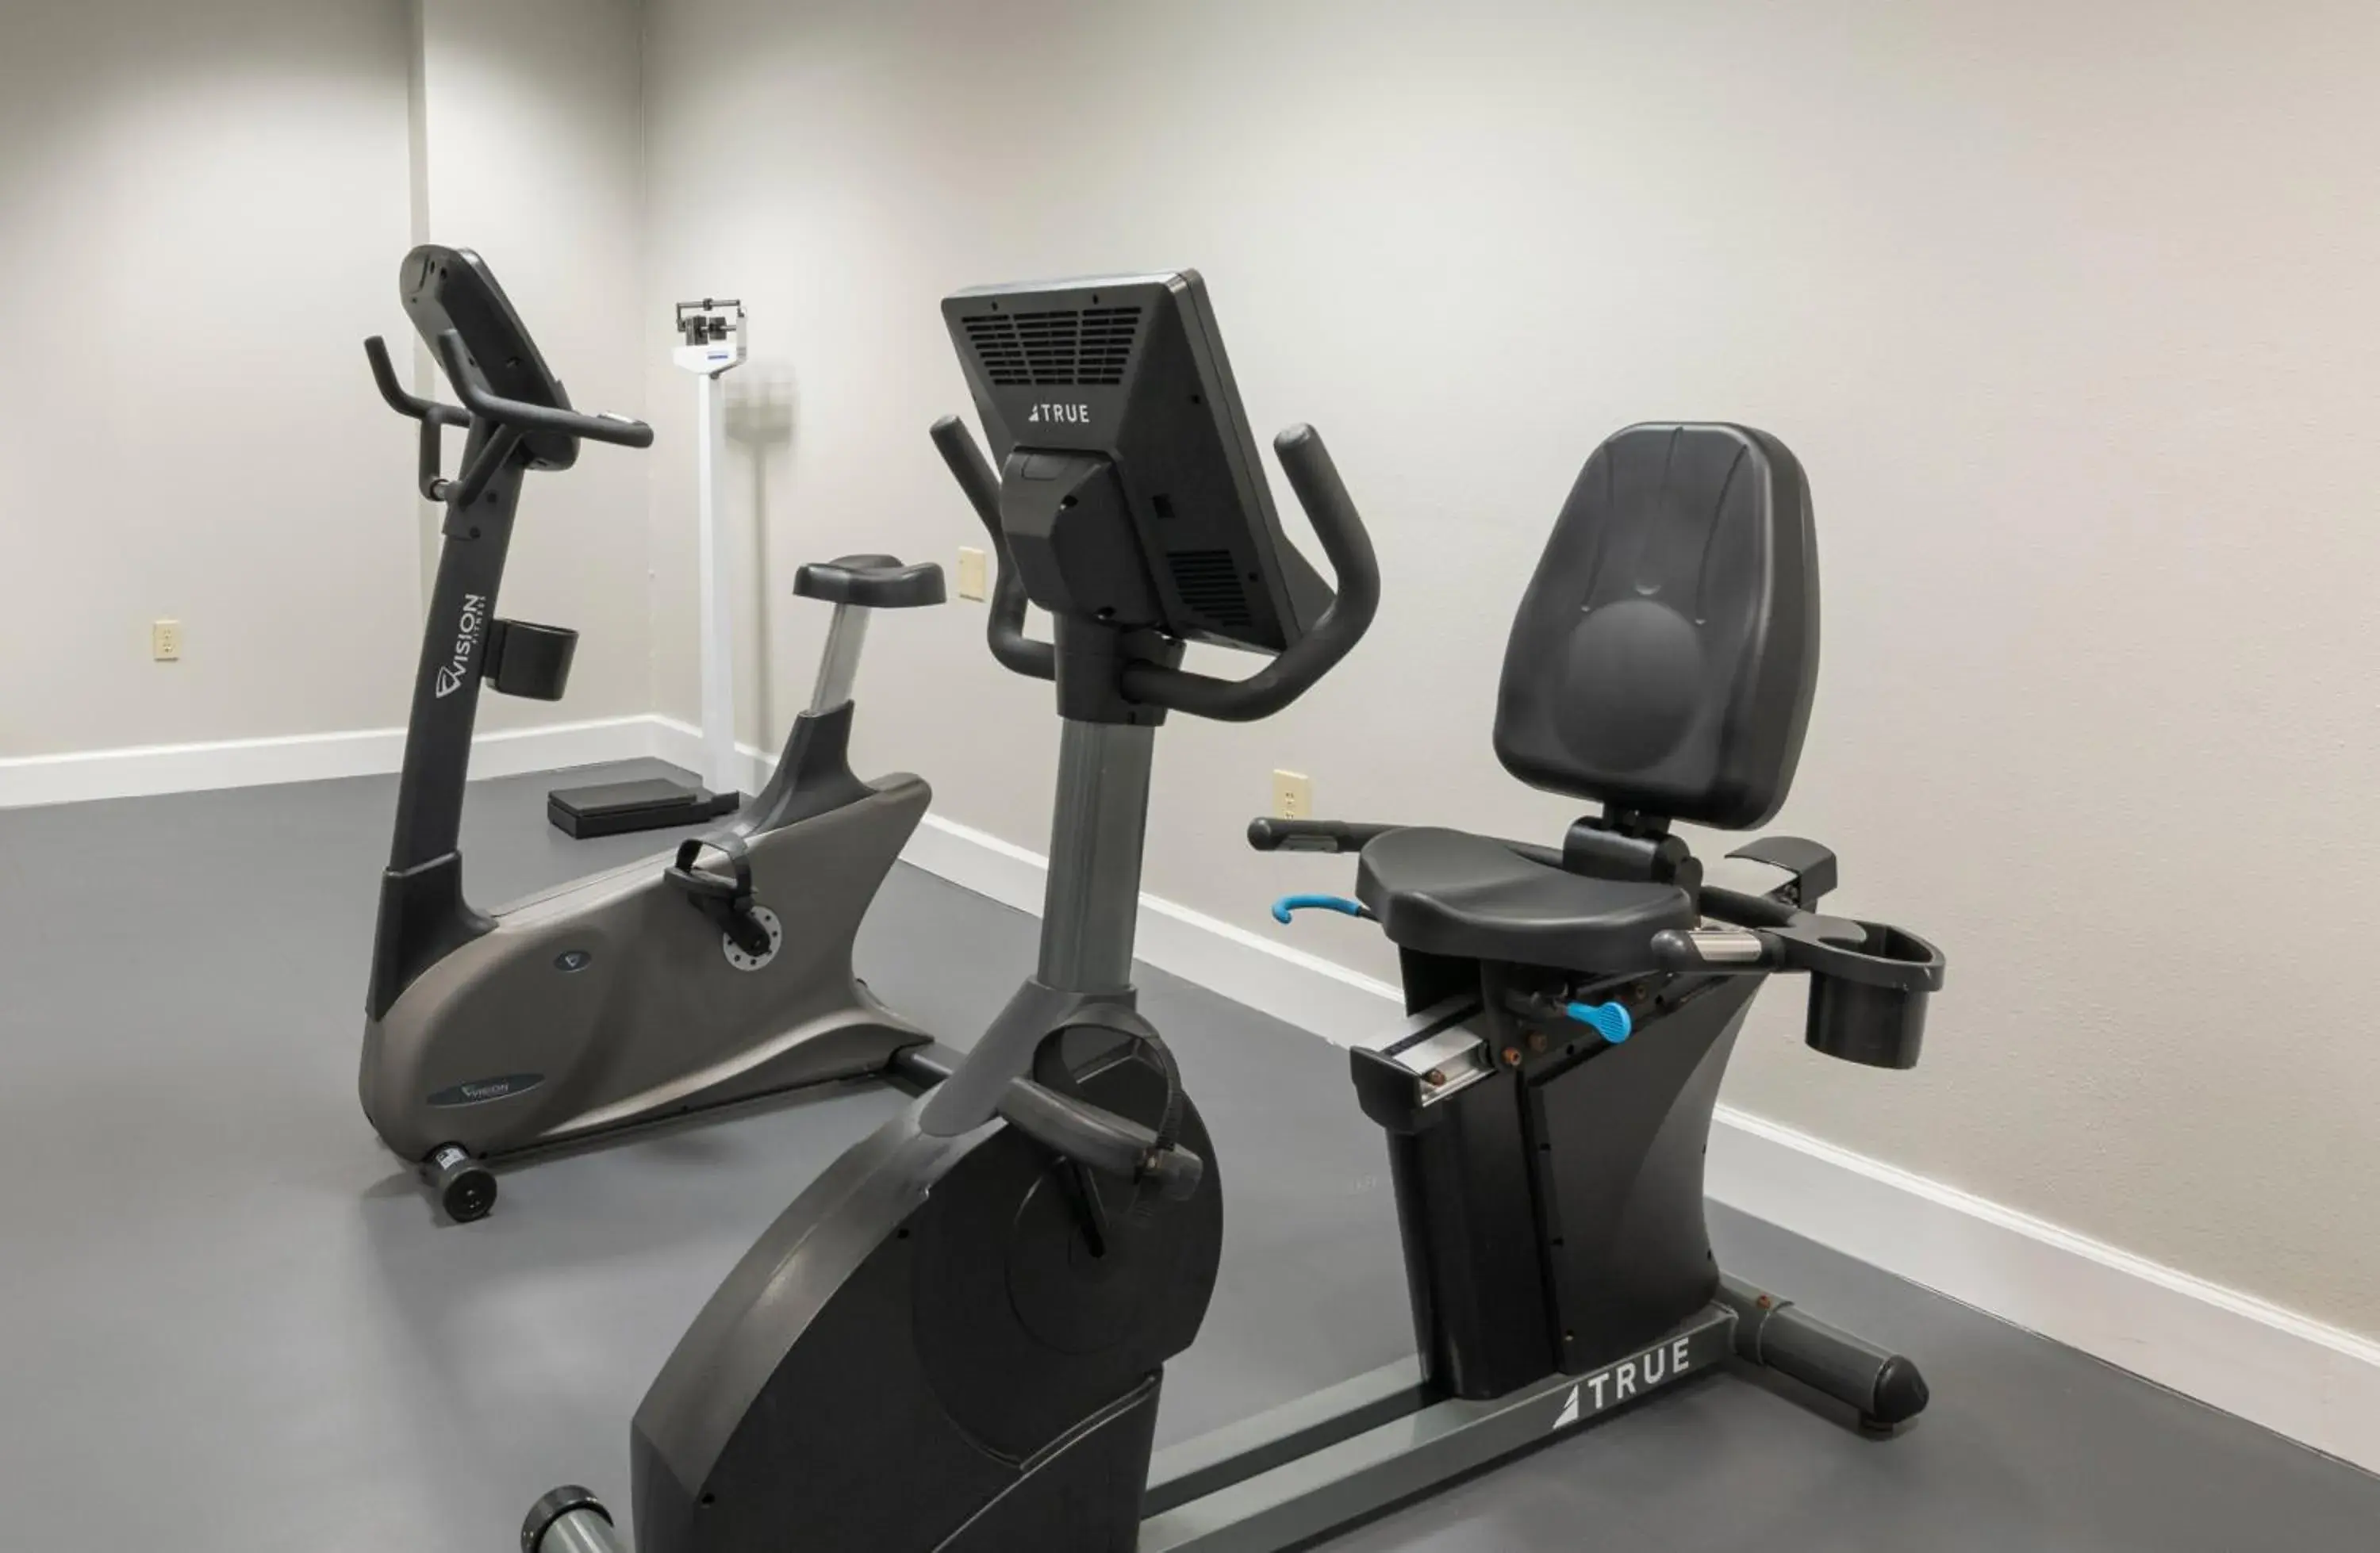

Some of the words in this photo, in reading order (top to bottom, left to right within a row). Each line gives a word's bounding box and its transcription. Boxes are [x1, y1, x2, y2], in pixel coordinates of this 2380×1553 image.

[1040, 403, 1090, 423] TRUE
[452, 592, 479, 677] VISION
[1587, 1336, 1689, 1409] TRUE
